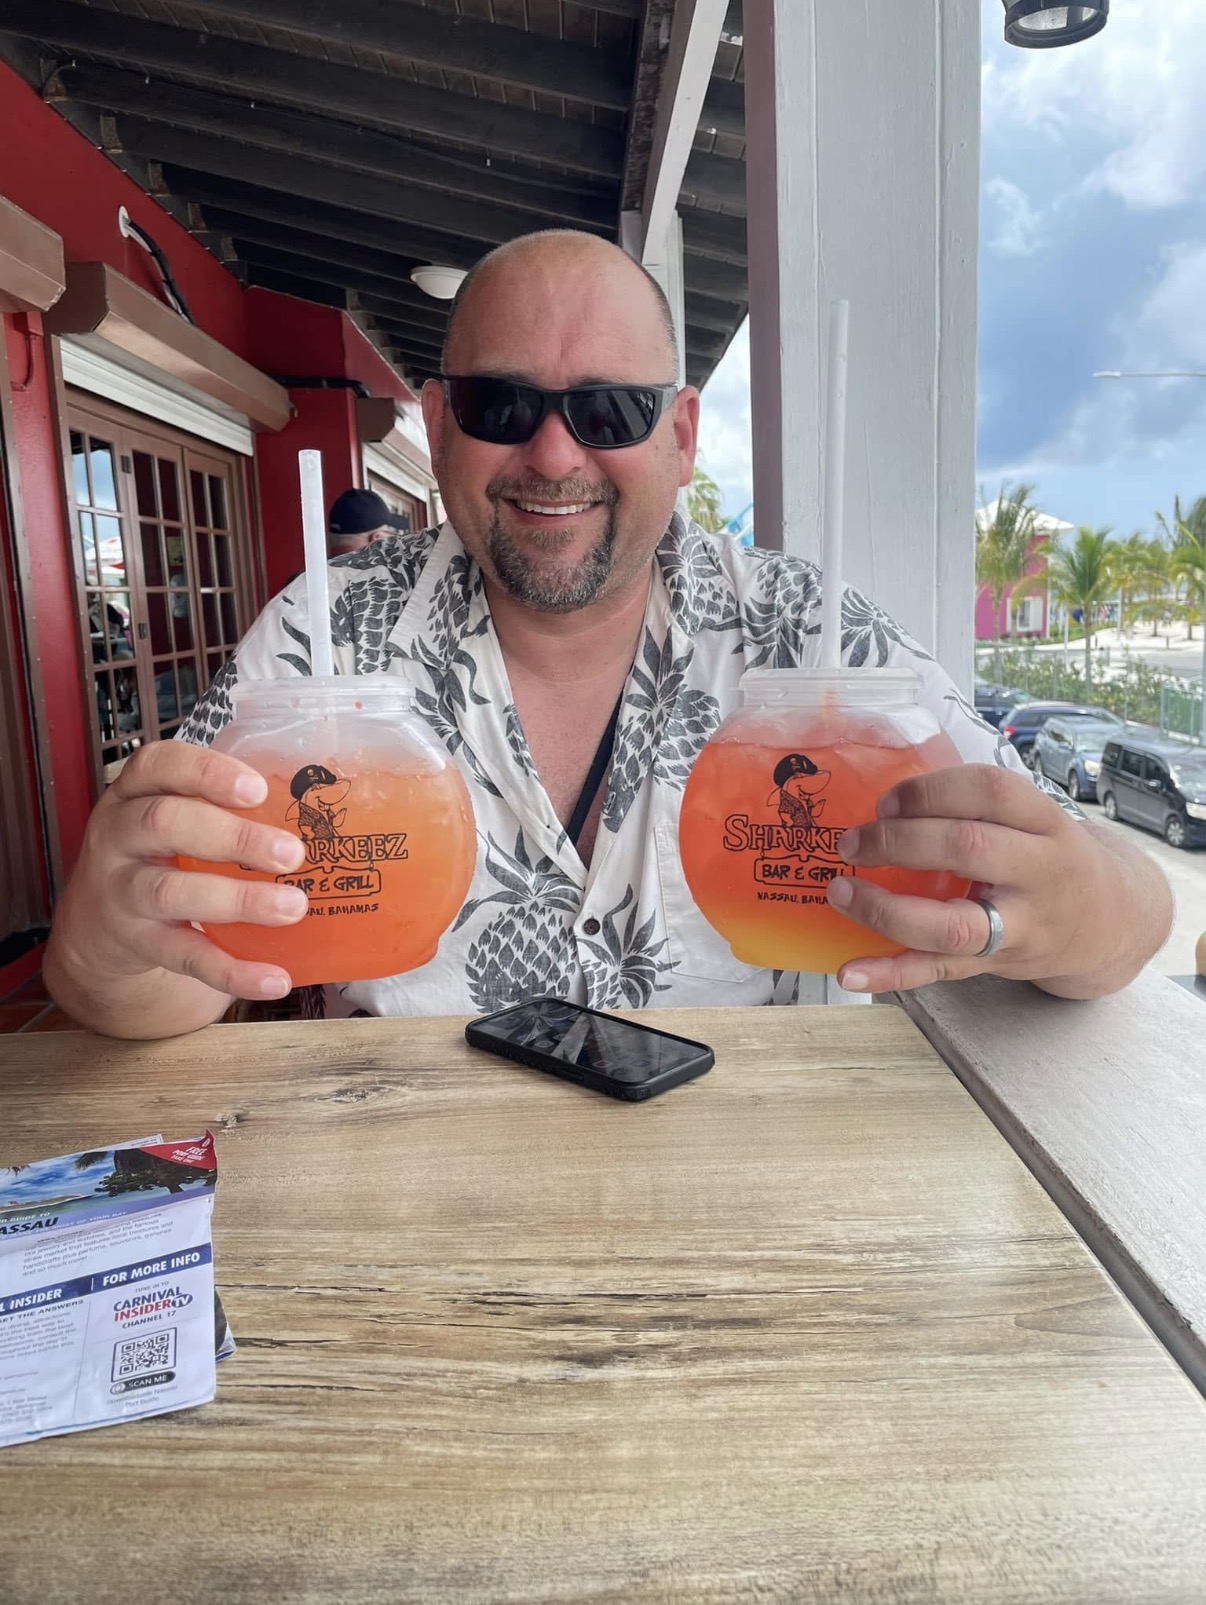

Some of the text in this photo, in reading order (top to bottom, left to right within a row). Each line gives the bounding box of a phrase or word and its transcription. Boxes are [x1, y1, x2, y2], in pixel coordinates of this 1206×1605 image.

[723, 813, 848, 855] SHARKE
[762, 864, 790, 880] BAR
[333, 875, 374, 892] GRILL
[327, 902, 379, 916] BAHAMAS
[801, 895, 829, 905] BAHA
[102, 1252, 200, 1287] FOR MORE INFO
[10, 1288, 63, 1310] INSIDER
[18, 1311, 35, 1319] THE
[38, 1299, 84, 1314] ANSWERS
[113, 1286, 183, 1312] CARNIVAL
[114, 1299, 172, 1322] INSIDER
[122, 1309, 177, 1329] CHANNEL 17
[128, 1374, 168, 1388] SCAN ME
